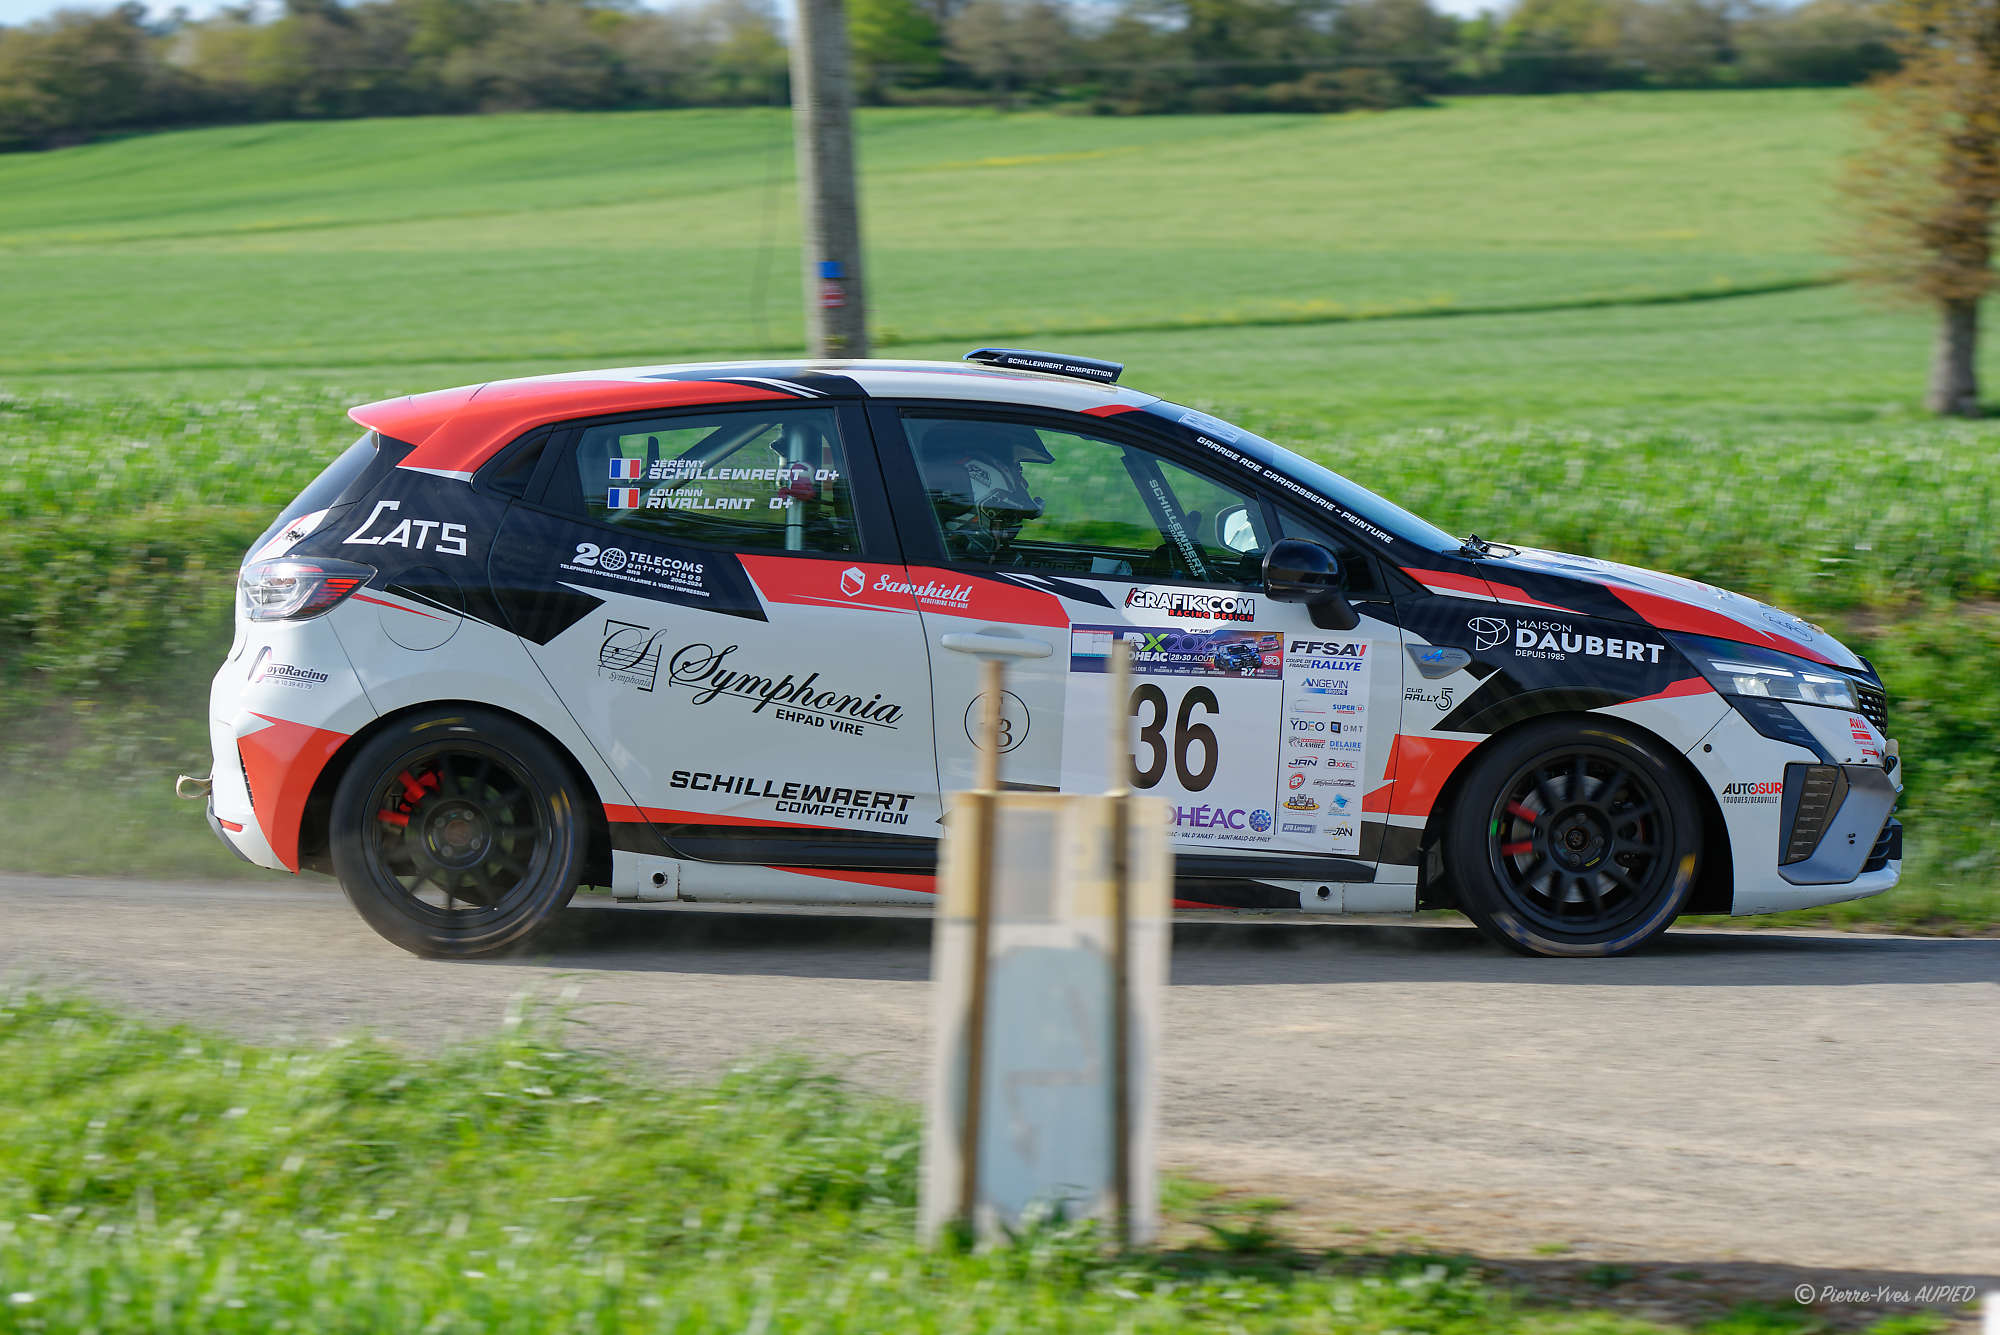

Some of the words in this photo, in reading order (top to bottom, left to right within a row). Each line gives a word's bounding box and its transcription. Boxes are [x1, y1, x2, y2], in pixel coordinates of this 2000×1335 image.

[1007, 357, 1063, 370] SCHILLEWAERT
[1065, 365, 1113, 378] COMPETITION
[648, 467, 804, 481] SCHILLEWAERT
[649, 488, 673, 497] LOU
[675, 488, 704, 498] ANN
[1196, 436, 1241, 462] GARAGE
[1262, 469, 1336, 512] CARROSSERIE
[1341, 510, 1395, 545] PEINTURE
[645, 497, 756, 510] RIVALLANT
[1149, 479, 1207, 575] SCHILLEWAERT
[629, 551, 705, 574] TELECOMS
[626, 562, 703, 582] entreprises
[872, 574, 974, 602] Samshield
[1168, 608, 1210, 620] RACING
[1213, 612, 1255, 623] DESIGN
[1516, 618, 1573, 633] MAISON
[1290, 640, 1358, 657] FFSA
[1515, 628, 1666, 664] DAUBERT
[1515, 649, 1546, 660] DEPUIS
[1547, 652, 1566, 661] 1985
[1310, 659, 1363, 672] RALLYE
[609, 671, 651, 687] Symphonia
[669, 643, 904, 725] Symphonia
[1301, 678, 1349, 689] ANGEVIN
[1404, 694, 1440, 702] RALLY
[1436, 687, 1453, 711] 5
[775, 708, 825, 728] EHPAD
[829, 718, 865, 737] VIRE
[1127, 683, 1220, 792] 36
[1329, 740, 1361, 749] DELAIRE
[669, 769, 916, 812] SCHILLEWAERT
[1721, 782, 1783, 795] AUTOSUR
[775, 800, 910, 825] COMPETITION
[1332, 827, 1353, 837] JAN
